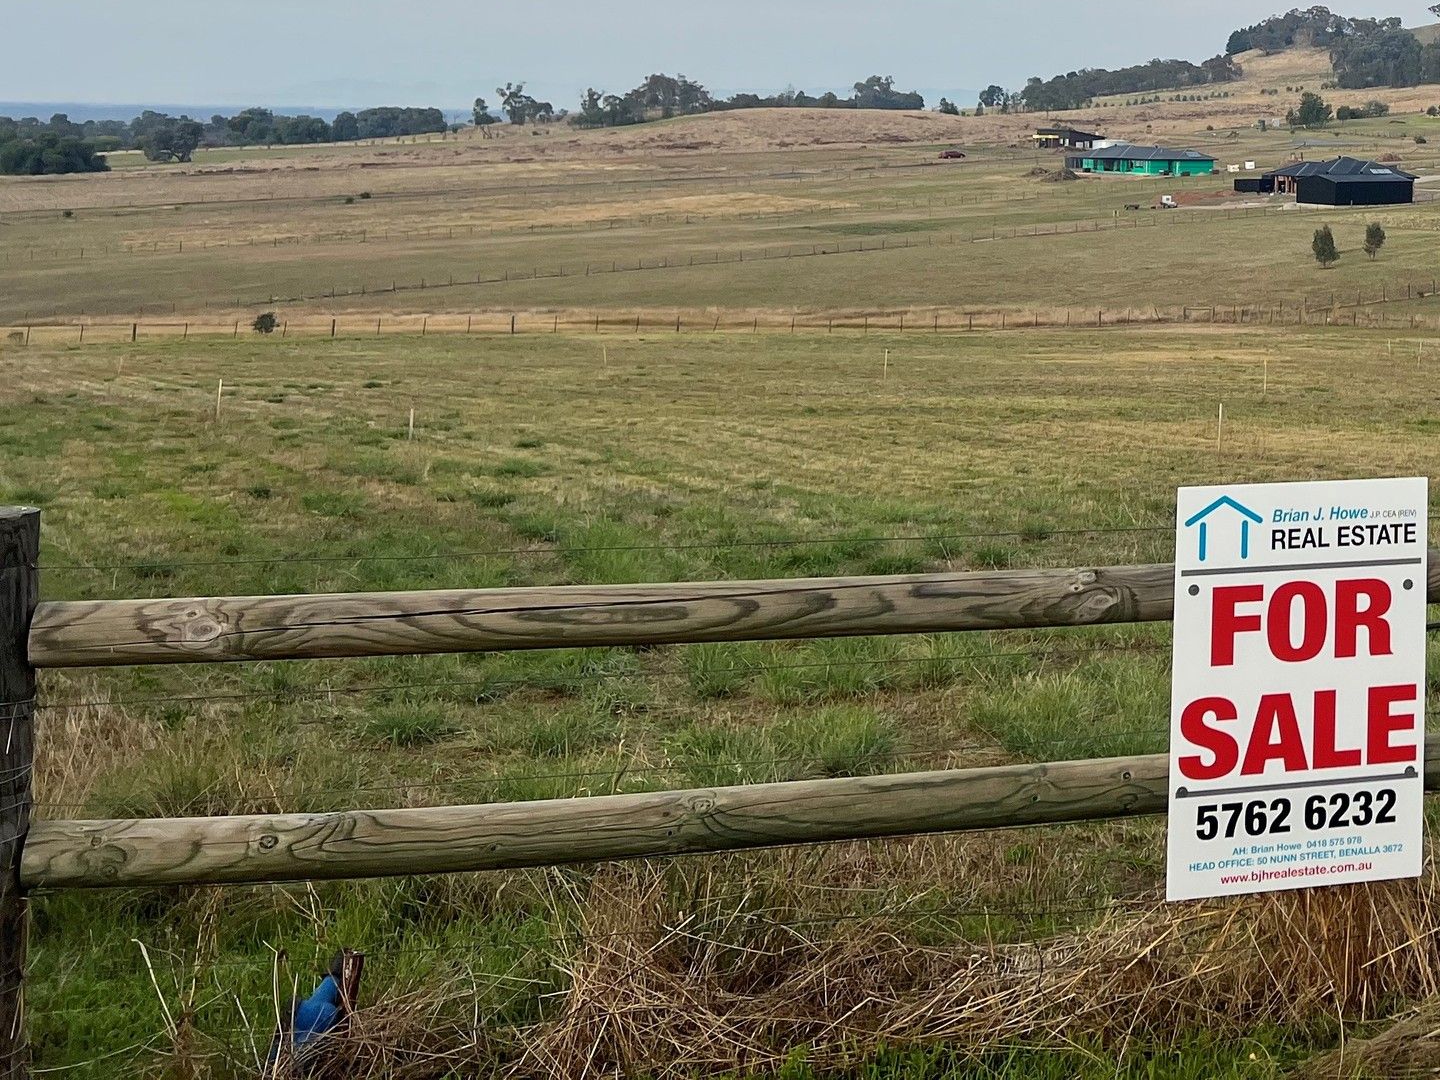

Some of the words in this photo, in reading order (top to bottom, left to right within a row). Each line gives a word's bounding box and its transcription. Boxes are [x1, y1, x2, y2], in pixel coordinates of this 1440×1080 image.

[1272, 509, 1309, 523] Brian
[1313, 507, 1325, 521] J.
[1329, 506, 1368, 520] Howe
[1271, 527, 1330, 550] REAL
[1337, 523, 1417, 547] ESTATE
[1210, 578, 1394, 667] FOR
[1178, 684, 1417, 780] SALE
[1196, 798, 1291, 841] 5762
[1304, 788, 1397, 831] 6232
[1189, 862, 1216, 872] HEAD
[1218, 858, 1255, 869] OFFICE:
[1257, 856, 1268, 865] 50
[1269, 854, 1298, 864] NUNN
[1299, 850, 1337, 861] STREET,
[1338, 846, 1381, 858] BENALLA
[1382, 843, 1404, 853] 3672
[1232, 847, 1249, 856] AH:
[1251, 844, 1275, 854] Brian
[1276, 842, 1302, 850] Howe
[1306, 839, 1328, 849] 0418
[1329, 837, 1345, 847] 575
[1220, 862, 1373, 885] www.bjhrealestate.com.au
